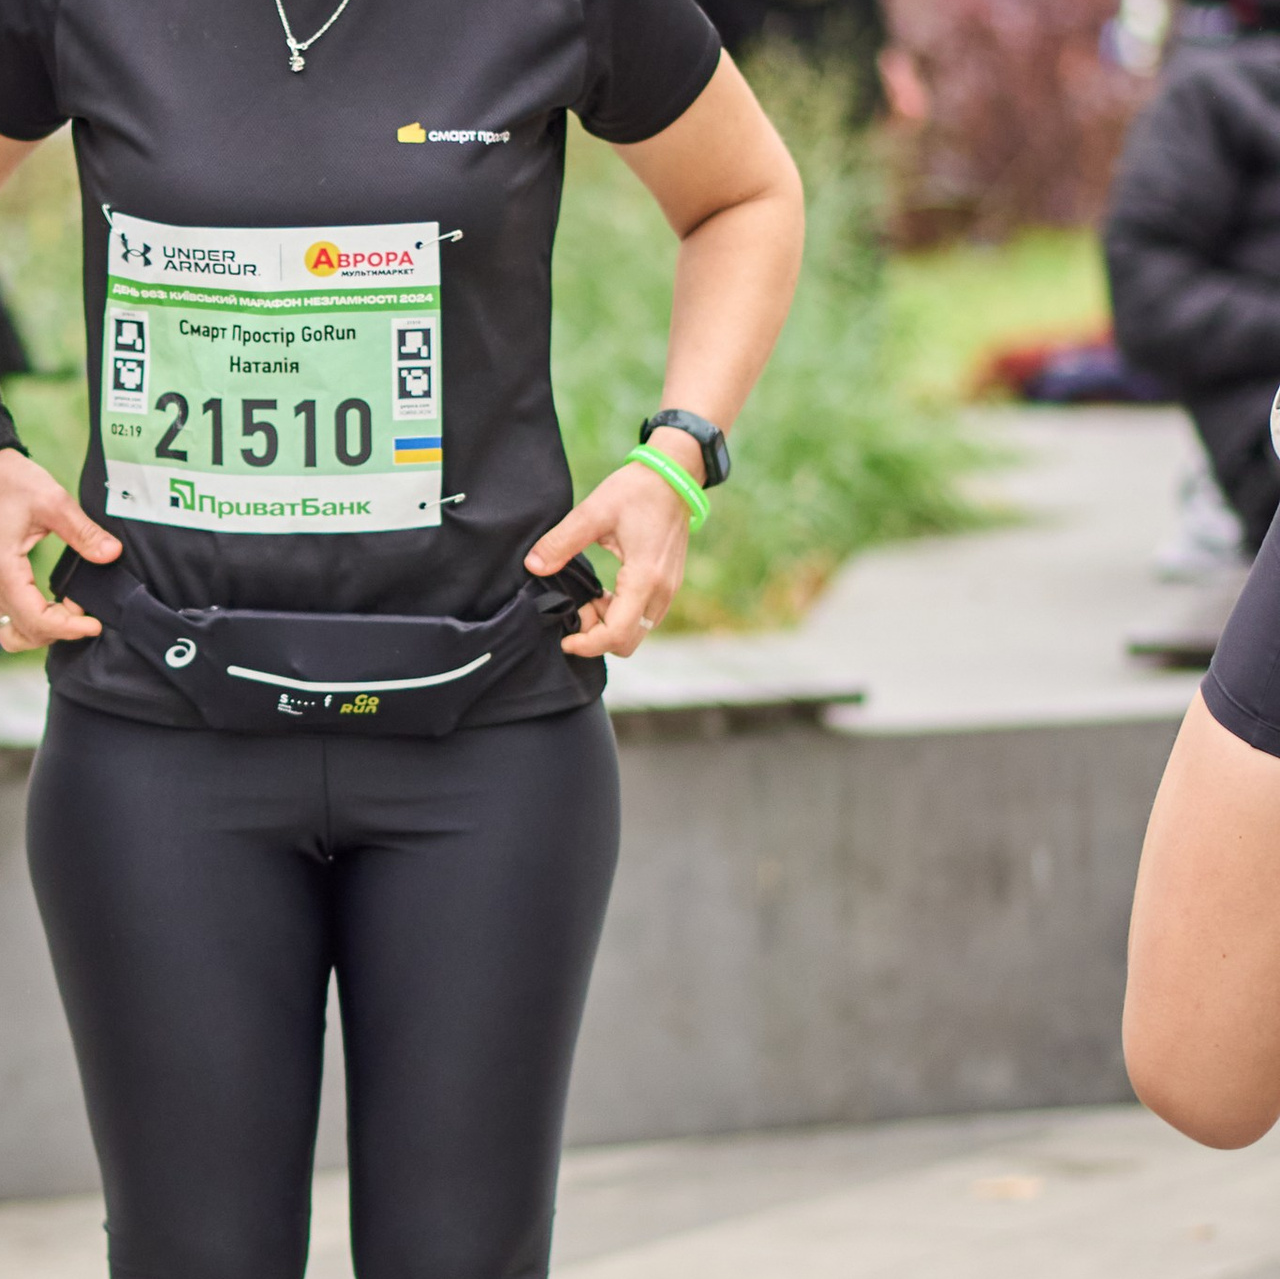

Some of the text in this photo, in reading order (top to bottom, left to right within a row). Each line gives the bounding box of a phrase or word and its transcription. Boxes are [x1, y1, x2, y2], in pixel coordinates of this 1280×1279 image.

[428, 130, 476, 144] смарт
[162, 246, 236, 263] UNDER
[311, 247, 415, 269] АВРОРА
[341, 267, 415, 278] МУЛЬТИМАРКЕТ
[112, 283, 140, 298] ДЕНЬ
[169, 290, 237, 306] КИЇВСЬКИЙ
[239, 296, 302, 309] МАРАФОН
[304, 294, 397, 307] НЕЗЛАМНОСТІ
[399, 293, 434, 303] 2024
[179, 319, 357, 347] Смарт Простір GoRun
[230, 356, 300, 374] Наталія
[111, 422, 142, 438] 02:19
[154, 391, 373, 469] 21510
[198, 494, 372, 519] ПриватБанк
[354, 693, 379, 706] Go
[340, 703, 378, 714] Run
